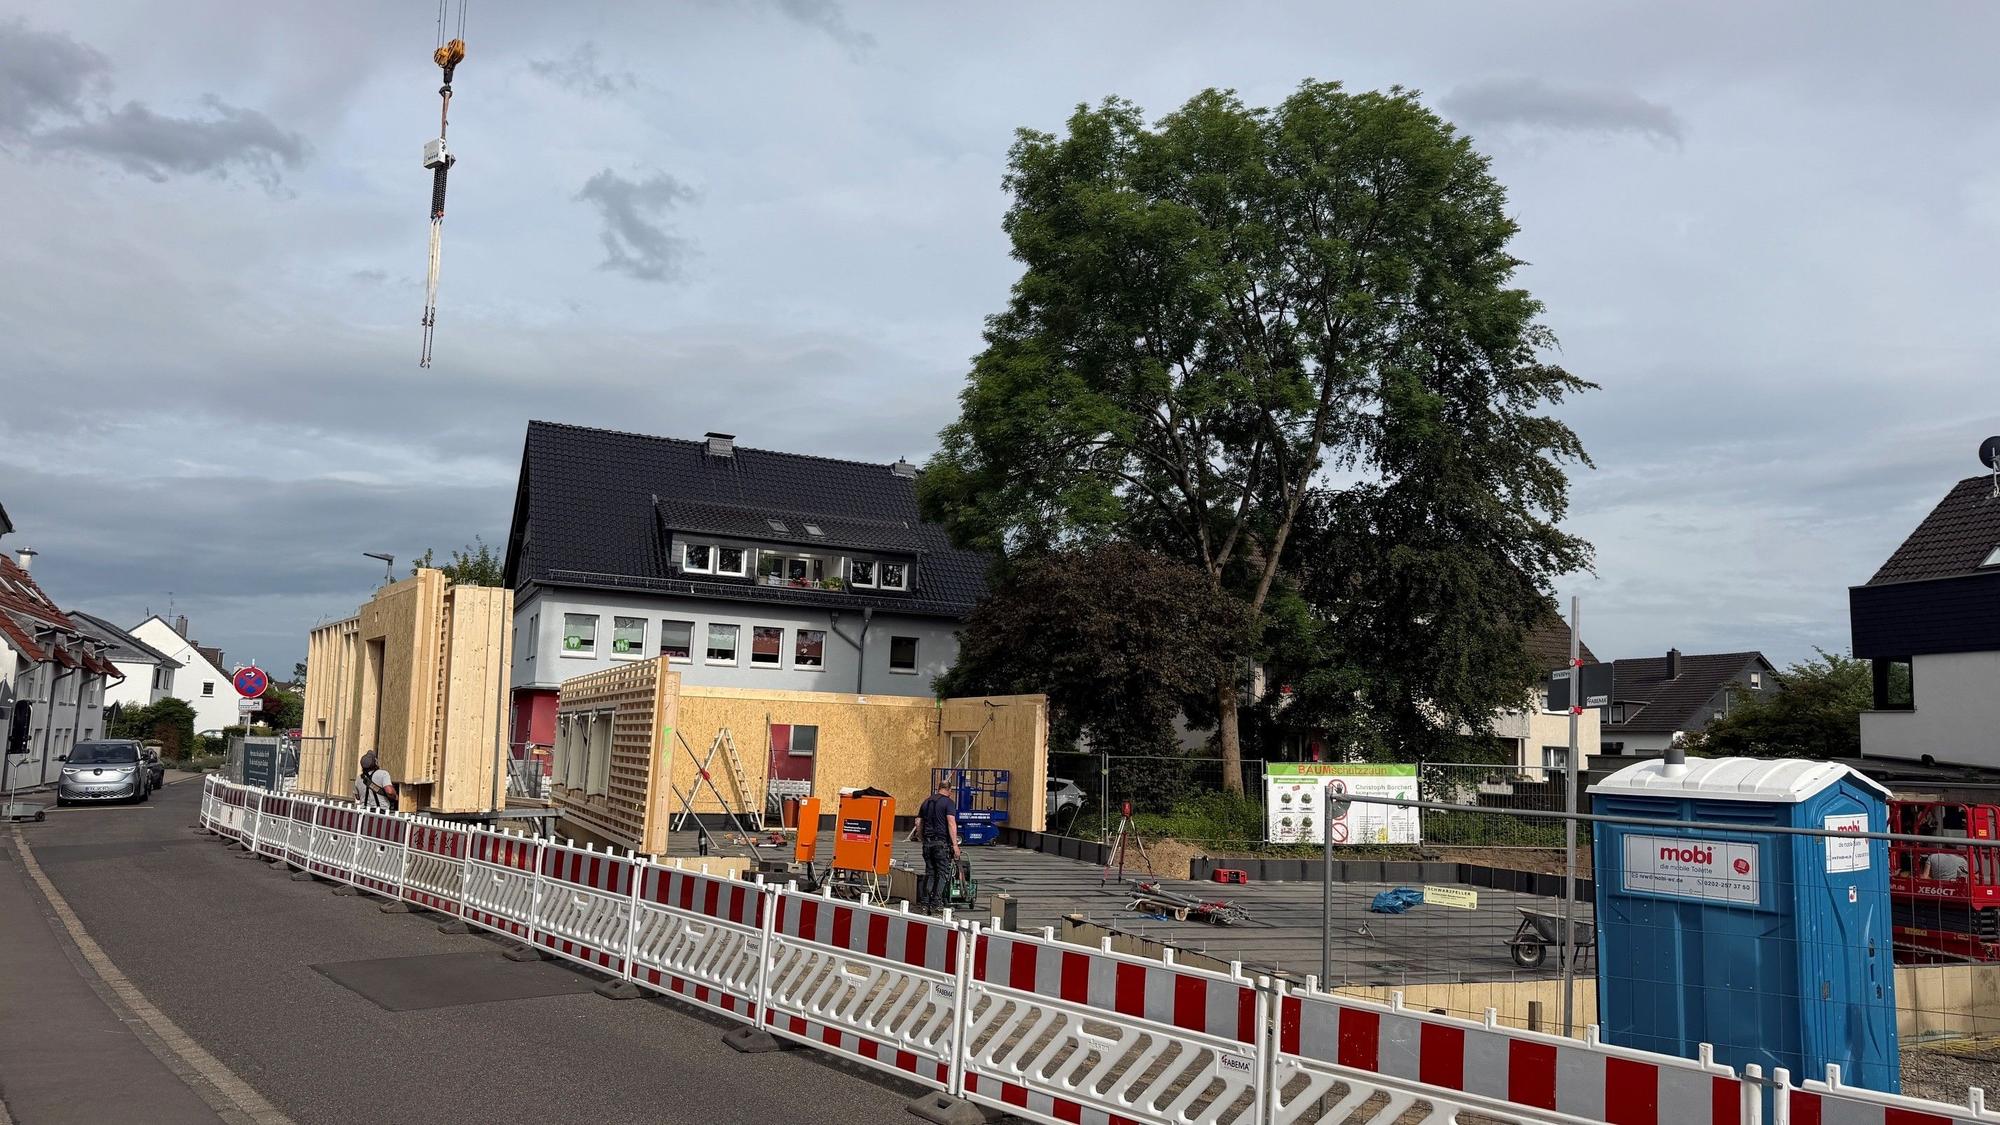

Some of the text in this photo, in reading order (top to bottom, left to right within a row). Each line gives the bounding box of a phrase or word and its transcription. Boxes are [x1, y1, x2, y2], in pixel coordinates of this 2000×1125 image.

[1298, 764, 1386, 775] BAUMschutzzaun
[1660, 845, 1712, 865] mobi
[1691, 866, 1713, 875] Toilette
[1918, 886, 1956, 896] XE60CT
[1224, 1058, 1250, 1071] FABEMA
